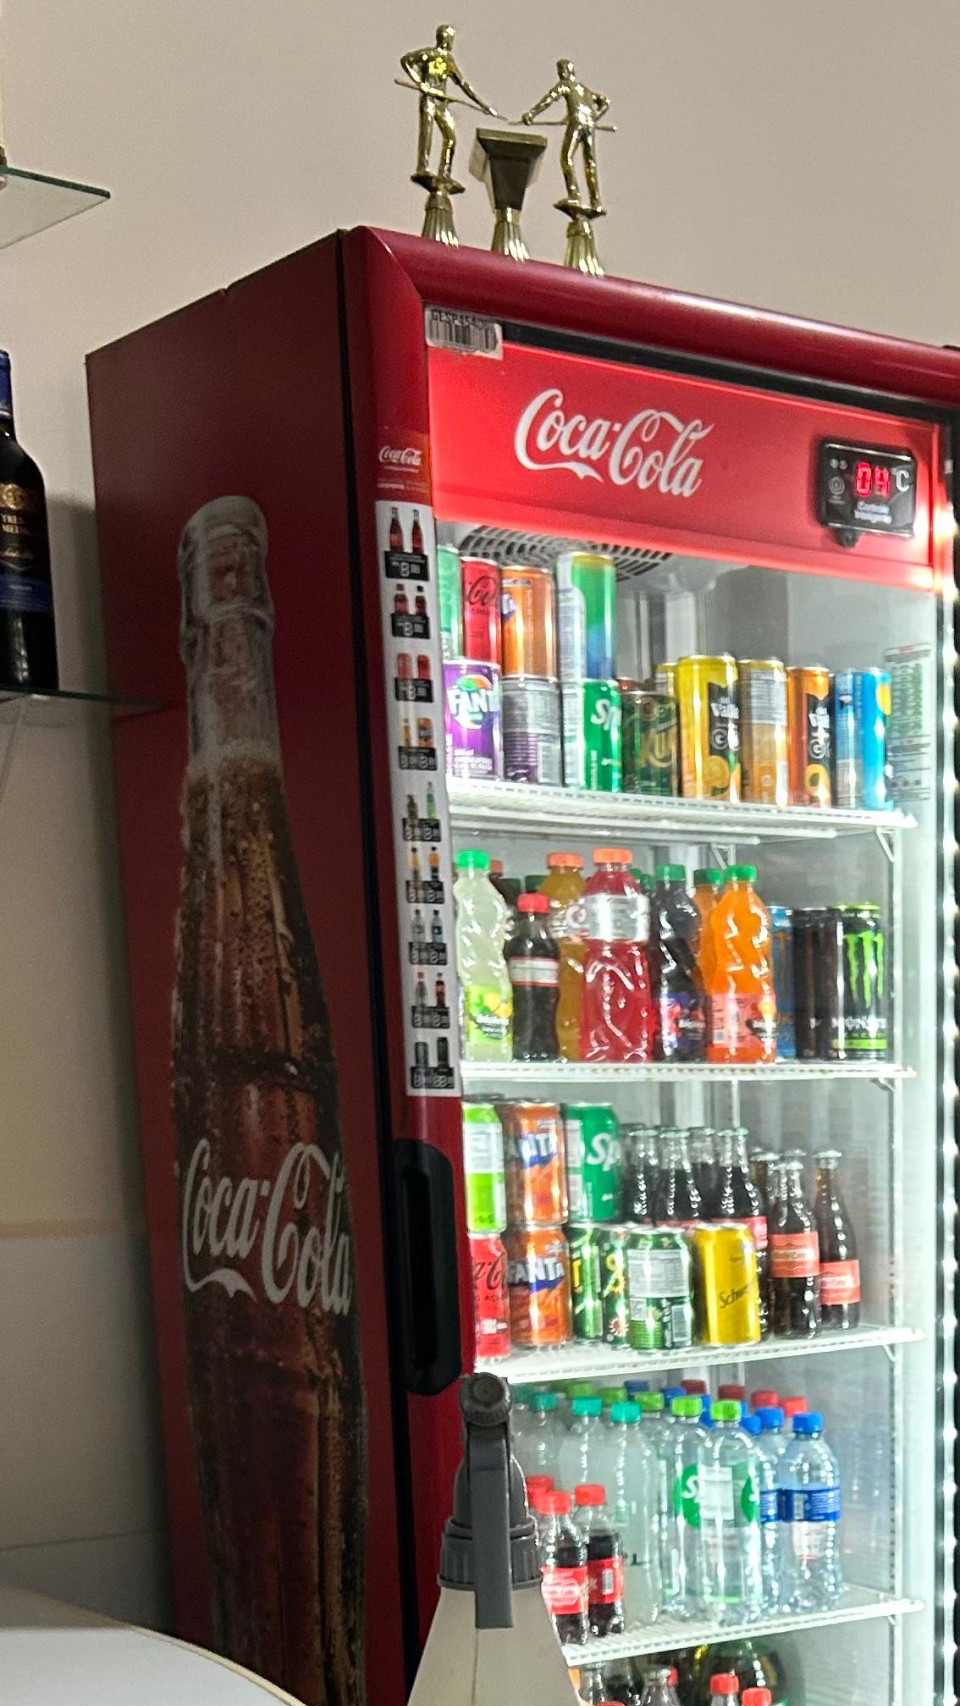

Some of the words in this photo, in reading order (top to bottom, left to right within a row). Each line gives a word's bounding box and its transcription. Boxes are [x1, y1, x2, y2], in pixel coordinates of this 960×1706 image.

[514, 389, 714, 497] Coca-Cola
[182, 1137, 351, 1316] Coca-Cola
[507, 1257, 565, 1284] FANTA
